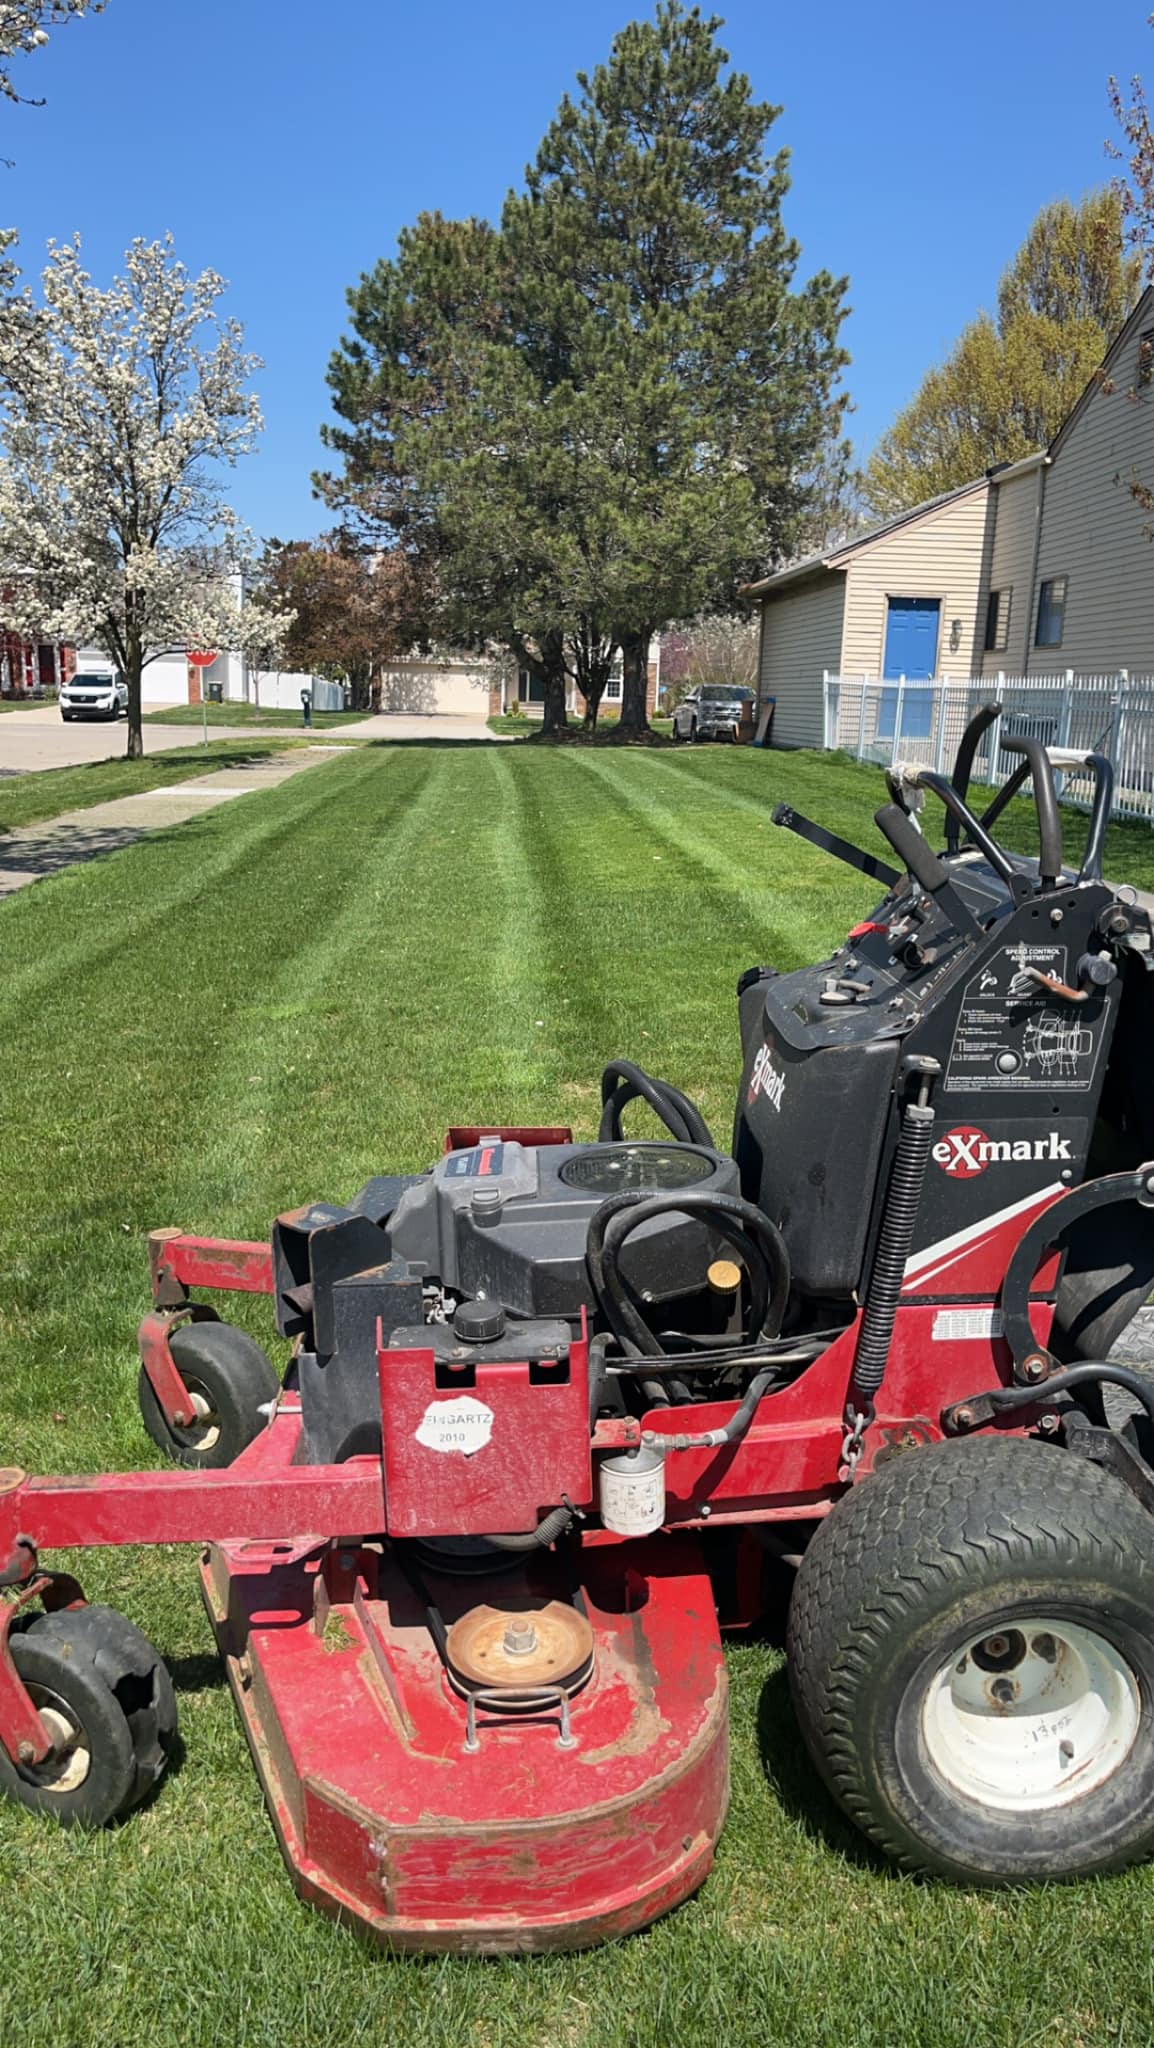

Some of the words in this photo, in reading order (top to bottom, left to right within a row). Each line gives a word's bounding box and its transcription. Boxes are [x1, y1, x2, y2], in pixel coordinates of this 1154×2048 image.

[751, 1043, 786, 1112] eXmark
[932, 1132, 1072, 1170] eXmark
[440, 1433, 465, 1442] 2010
